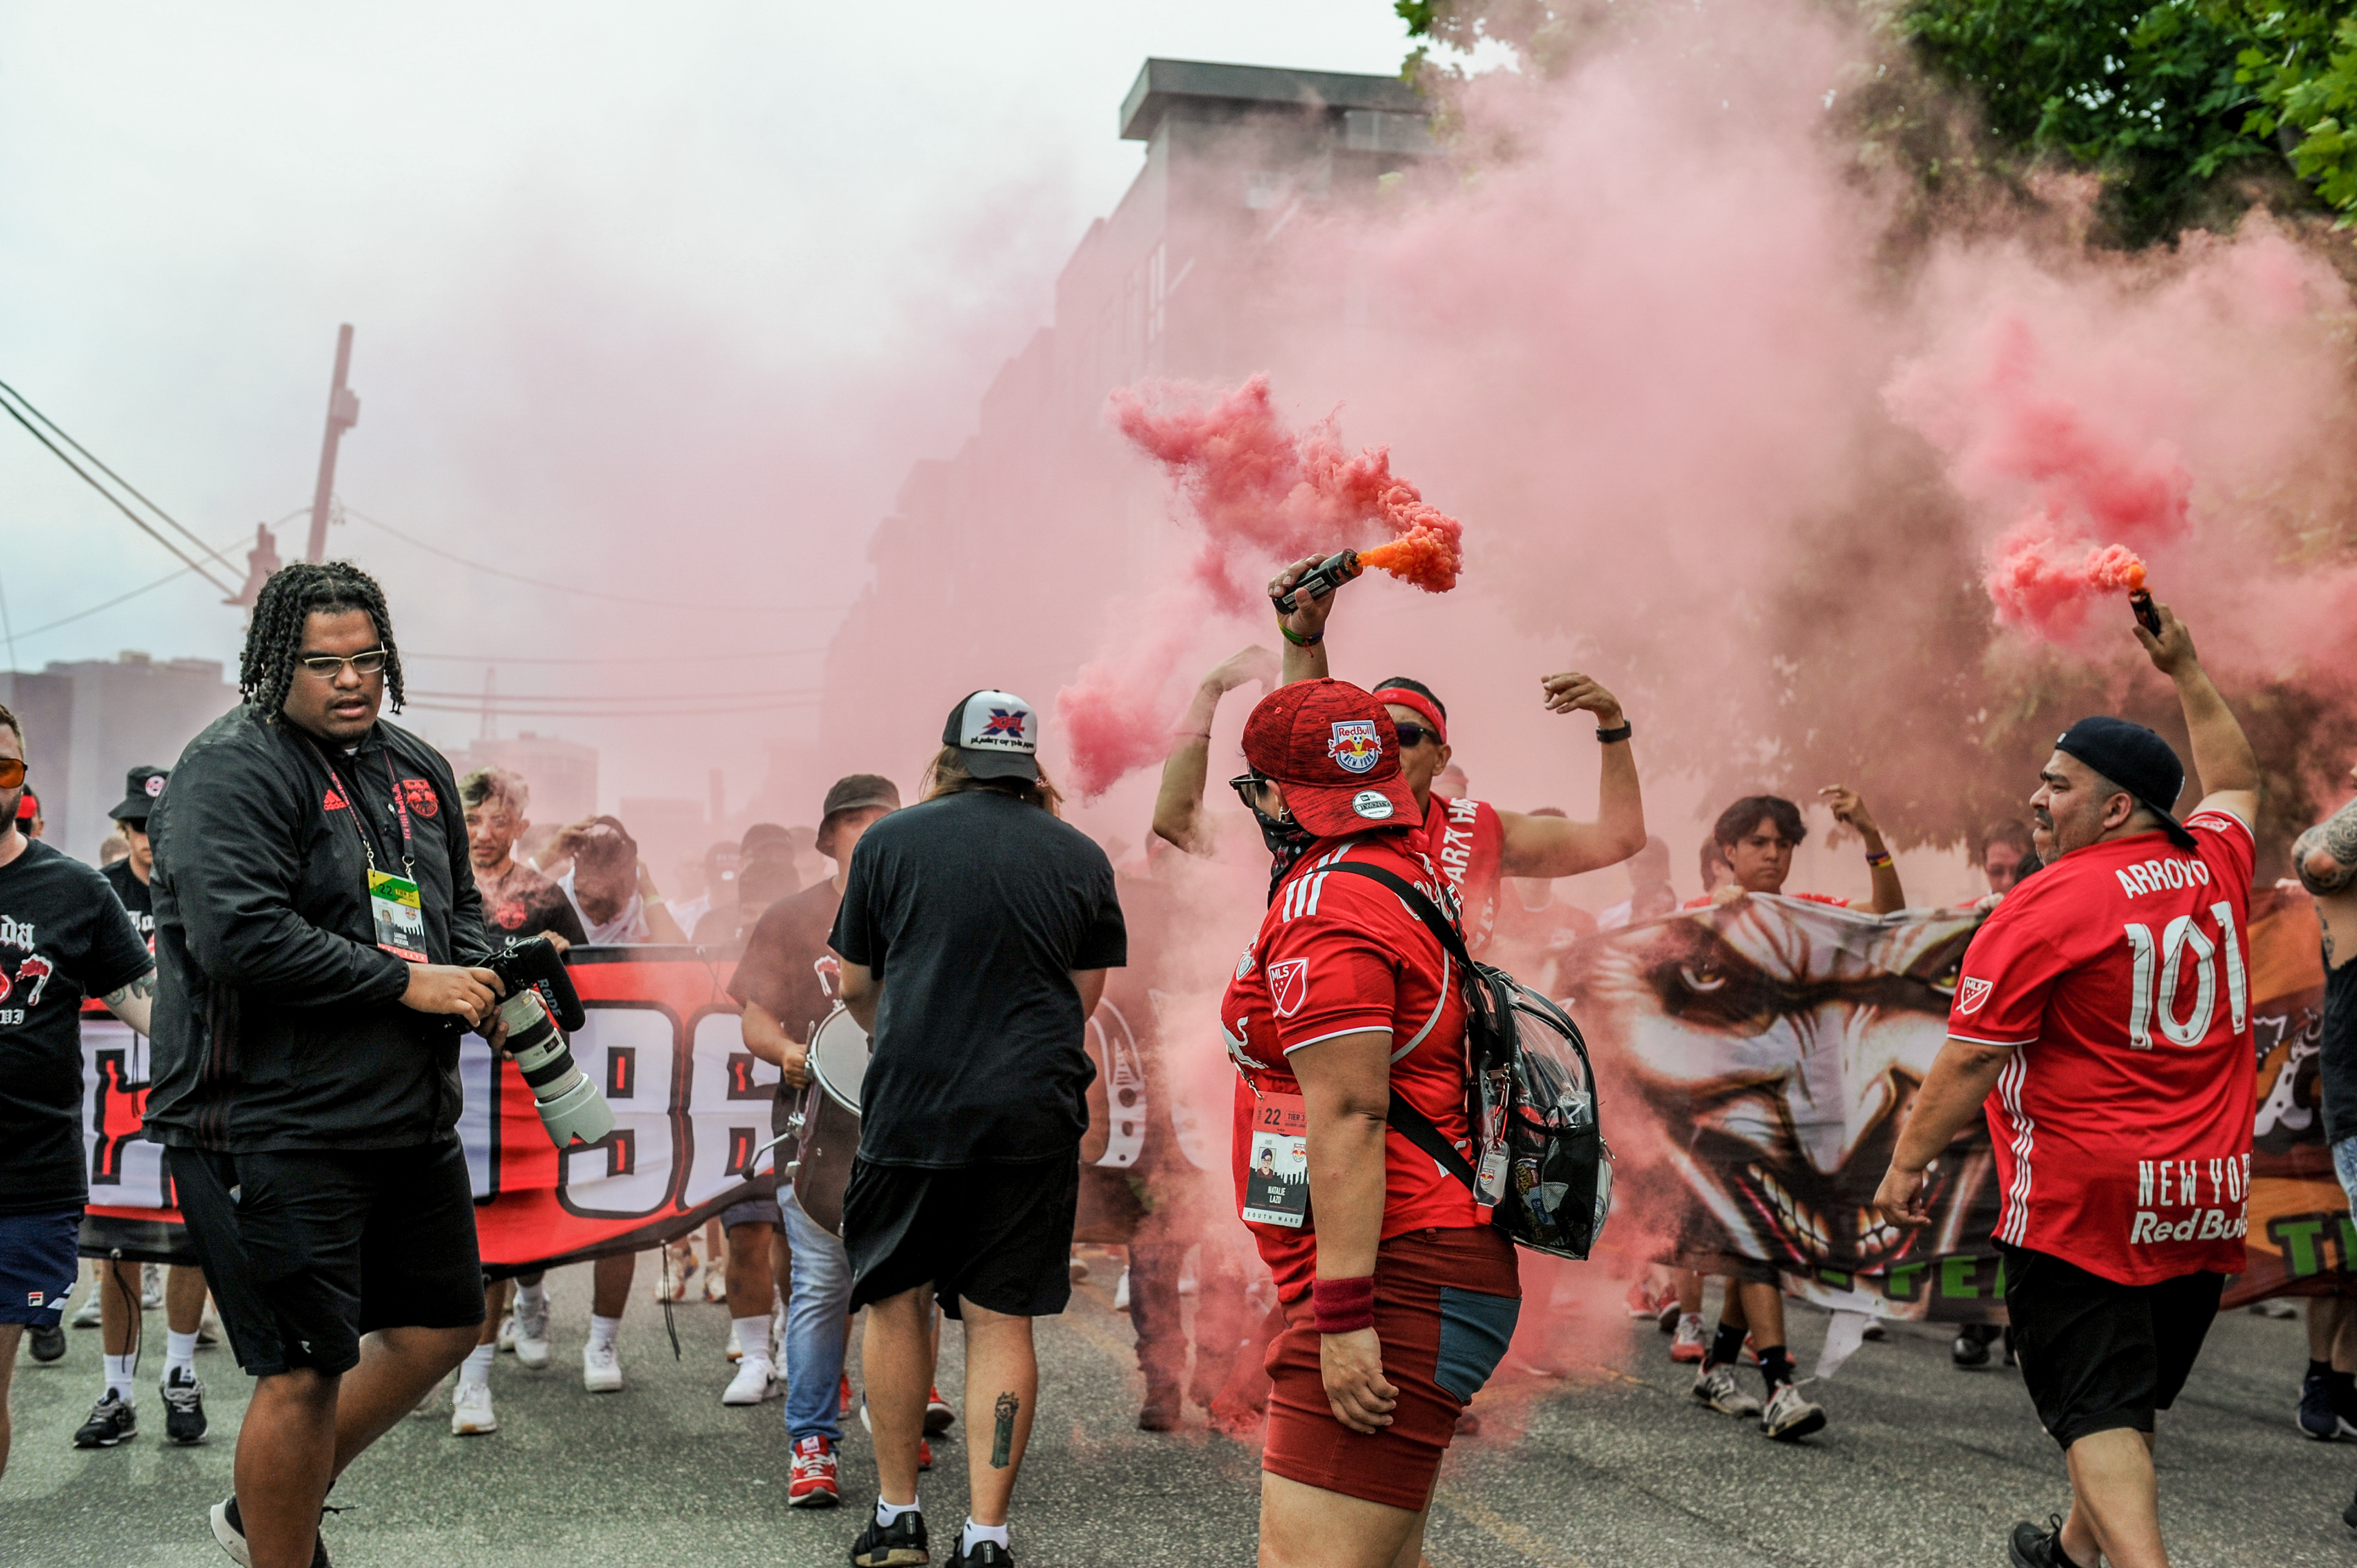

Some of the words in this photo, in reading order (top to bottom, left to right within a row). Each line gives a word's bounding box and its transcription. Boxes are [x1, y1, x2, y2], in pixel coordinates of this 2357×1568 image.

[983, 715, 1025, 732] XFL
[1339, 727, 1355, 736] Red
[1356, 725, 1372, 735] Bull
[1343, 755, 1358, 767] NEW
[1360, 752, 1374, 767] YORK
[1355, 801, 1389, 811] 9TWENTY
[1441, 825, 1473, 897] ARTY
[2115, 858, 2210, 899] ARROYO
[379, 884, 393, 897] 22
[1271, 966, 1290, 981] MLS
[2124, 900, 2246, 1051] 101
[1966, 980, 1983, 992] MLS
[1264, 1107, 1281, 1126] 22
[2138, 1159, 2197, 1207] NEW
[2209, 1152, 2253, 1204] YOR
[1268, 1186, 1286, 1196] NATALIE
[1269, 1195, 1282, 1204] LAZO
[1278, 1215, 1299, 1224] WARD
[2131, 1208, 2202, 1245] Red
